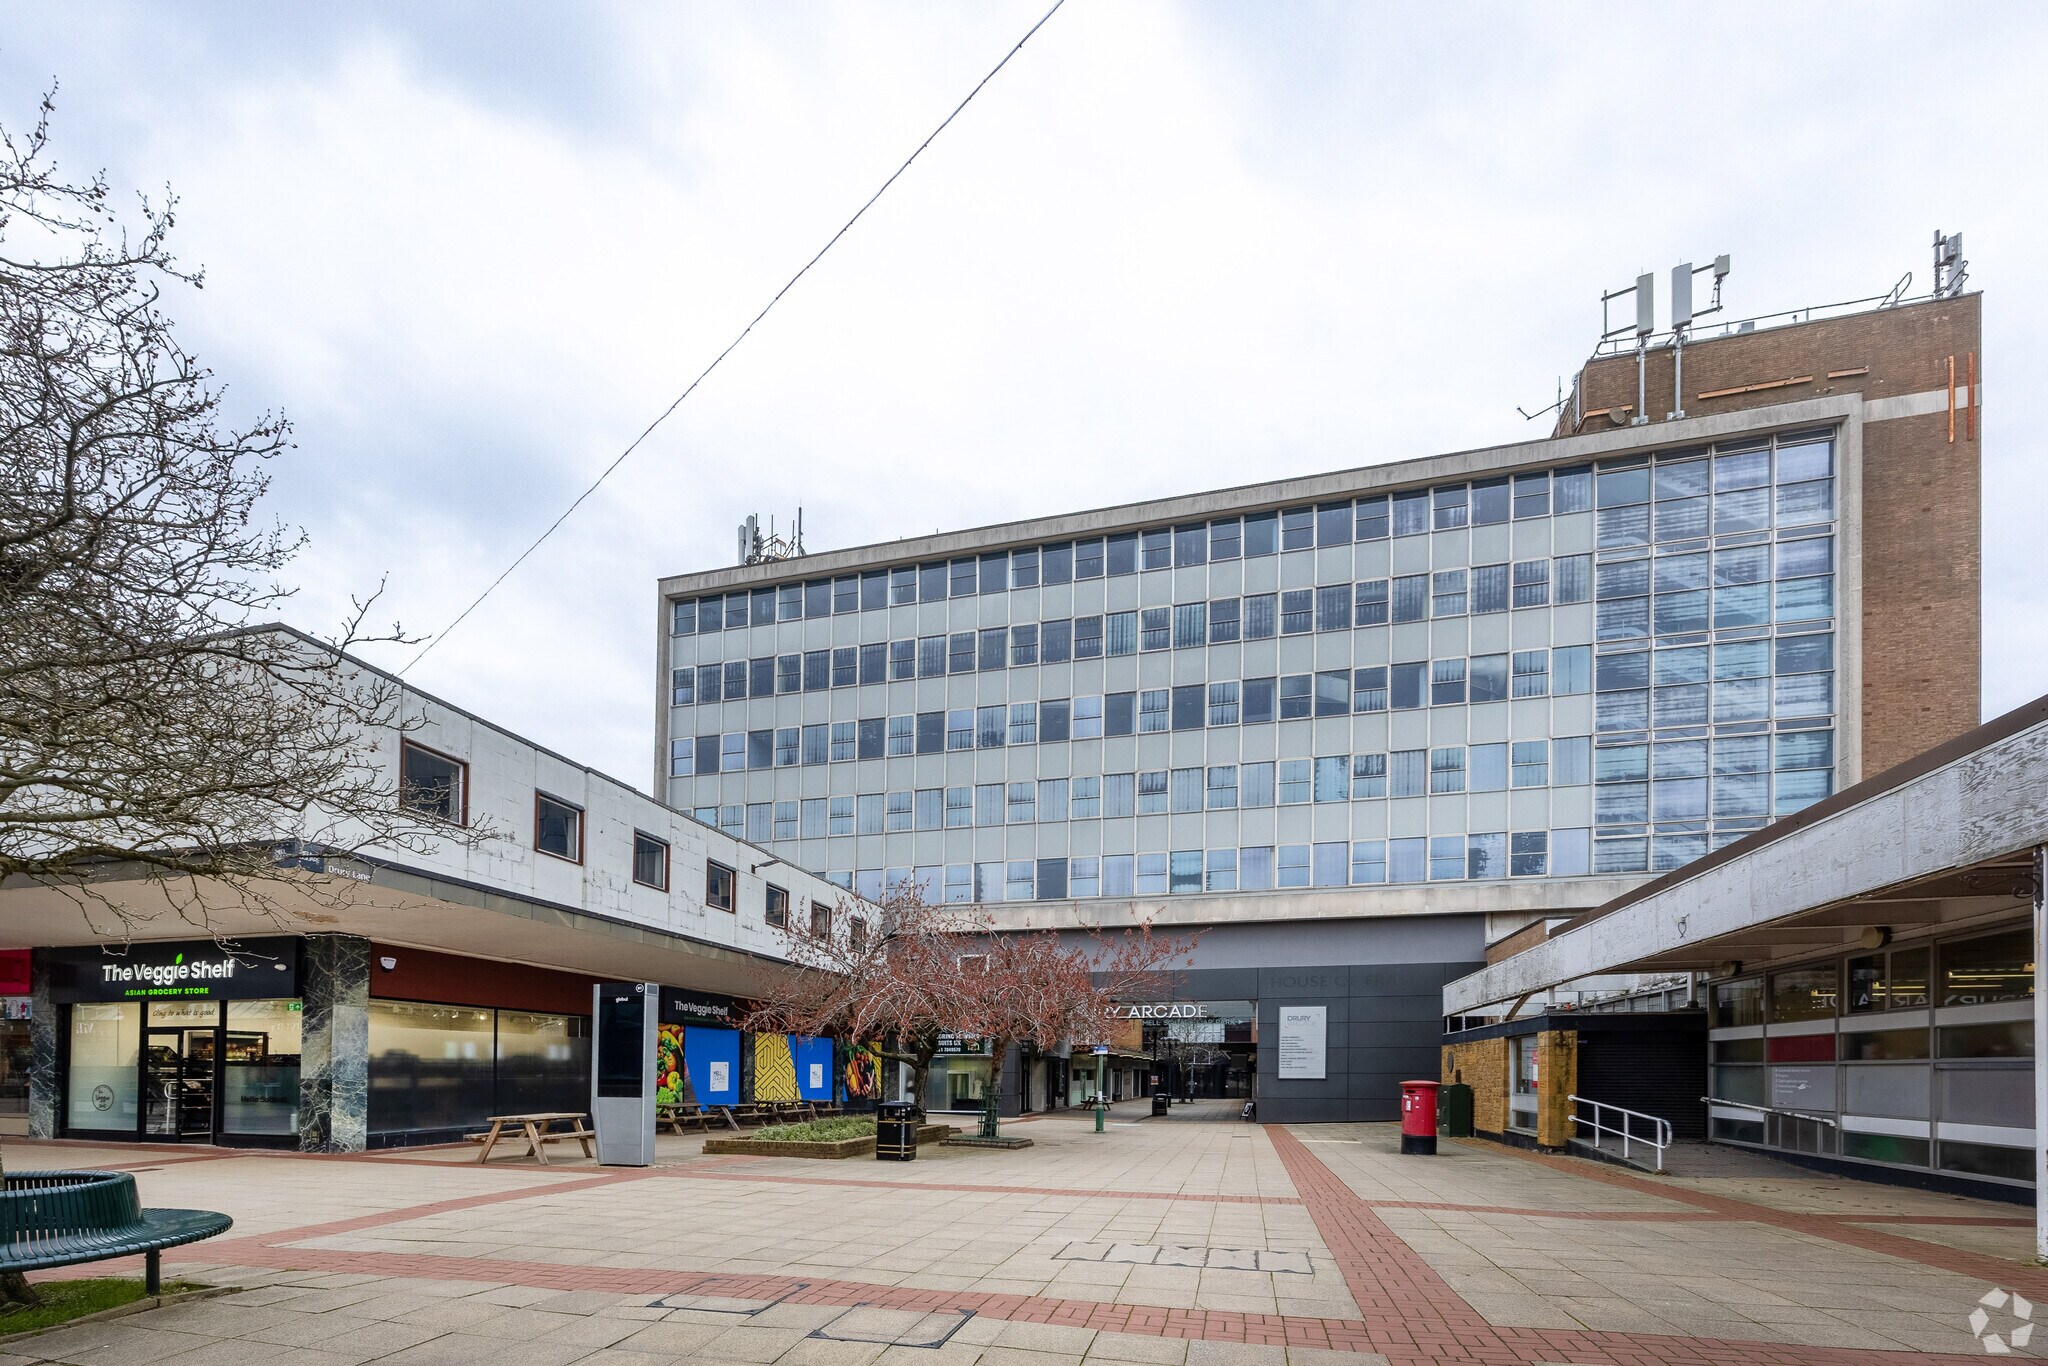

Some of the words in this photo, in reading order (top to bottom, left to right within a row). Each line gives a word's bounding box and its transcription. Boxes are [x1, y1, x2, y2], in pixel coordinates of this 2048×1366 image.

[328, 865, 350, 878] Drury
[352, 870, 371, 882] Lane
[102, 964, 133, 982] The
[133, 963, 190, 986] Veggie
[190, 958, 236, 979] Shelf
[148, 988, 182, 996] GROCERY
[184, 987, 209, 995] STORE
[199, 1008, 215, 1018] good
[674, 1000, 688, 1011] The
[688, 1003, 712, 1016] Veggie
[712, 1006, 729, 1016] Shelf
[1128, 1004, 1208, 1018] ARCADE
